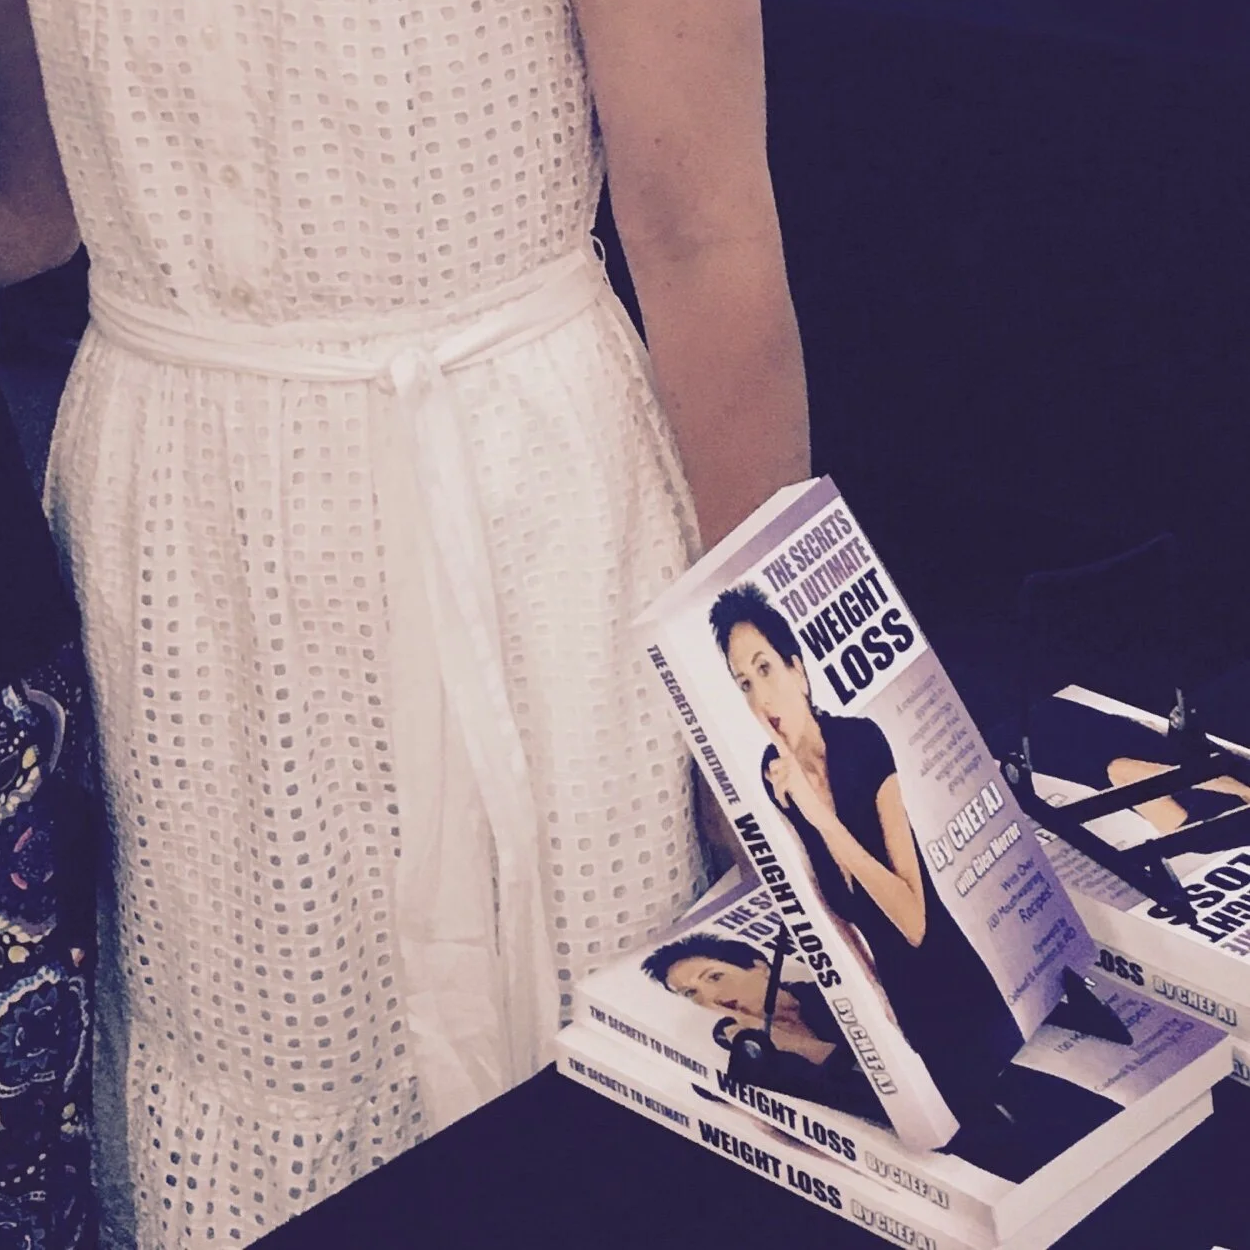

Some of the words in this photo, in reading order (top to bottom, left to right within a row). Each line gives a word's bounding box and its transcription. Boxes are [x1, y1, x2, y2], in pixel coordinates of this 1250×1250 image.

[762, 554, 798, 593] THE
[788, 508, 852, 572] SECRETS
[780, 590, 808, 624] TO
[800, 536, 870, 607] ULTIMATE
[798, 566, 888, 662] WEIGHT
[823, 608, 914, 706] LOSS
[946, 796, 986, 852] CHEF
[980, 780, 1004, 818] AJ
[646, 644, 668, 670] THE
[660, 670, 698, 726] SECRETS
[690, 726, 708, 744] TO
[701, 745, 741, 806] ULTIMATE
[734, 812, 806, 918] WEIGHT
[792, 920, 842, 990] LOSS
[848, 1024, 885, 1070] CHEF
[872, 1072, 898, 1094] AJ
[713, 905, 759, 930] THE
[737, 922, 774, 942] TO
[1175, 985, 1216, 1016] CHEF
[1218, 1003, 1237, 1026] AJ
[568, 1056, 585, 1076] THE
[587, 1068, 628, 1098] SECRETS
[630, 1088, 643, 1104] TO
[644, 1096, 690, 1128] ULTIMATE
[698, 1120, 782, 1178] WEIGHT
[786, 1164, 842, 1210] LOSS
[874, 1212, 915, 1246] CHEF
[590, 1006, 606, 1024] THE
[608, 1015, 648, 1046] SECRETS
[650, 1038, 662, 1054] TO
[664, 1046, 709, 1080] ULTIMATE
[716, 1069, 797, 1130] WEIGHT
[802, 1115, 856, 1162] LOSS
[887, 1165, 928, 1198] CHEF
[926, 1186, 950, 1210] AJ
